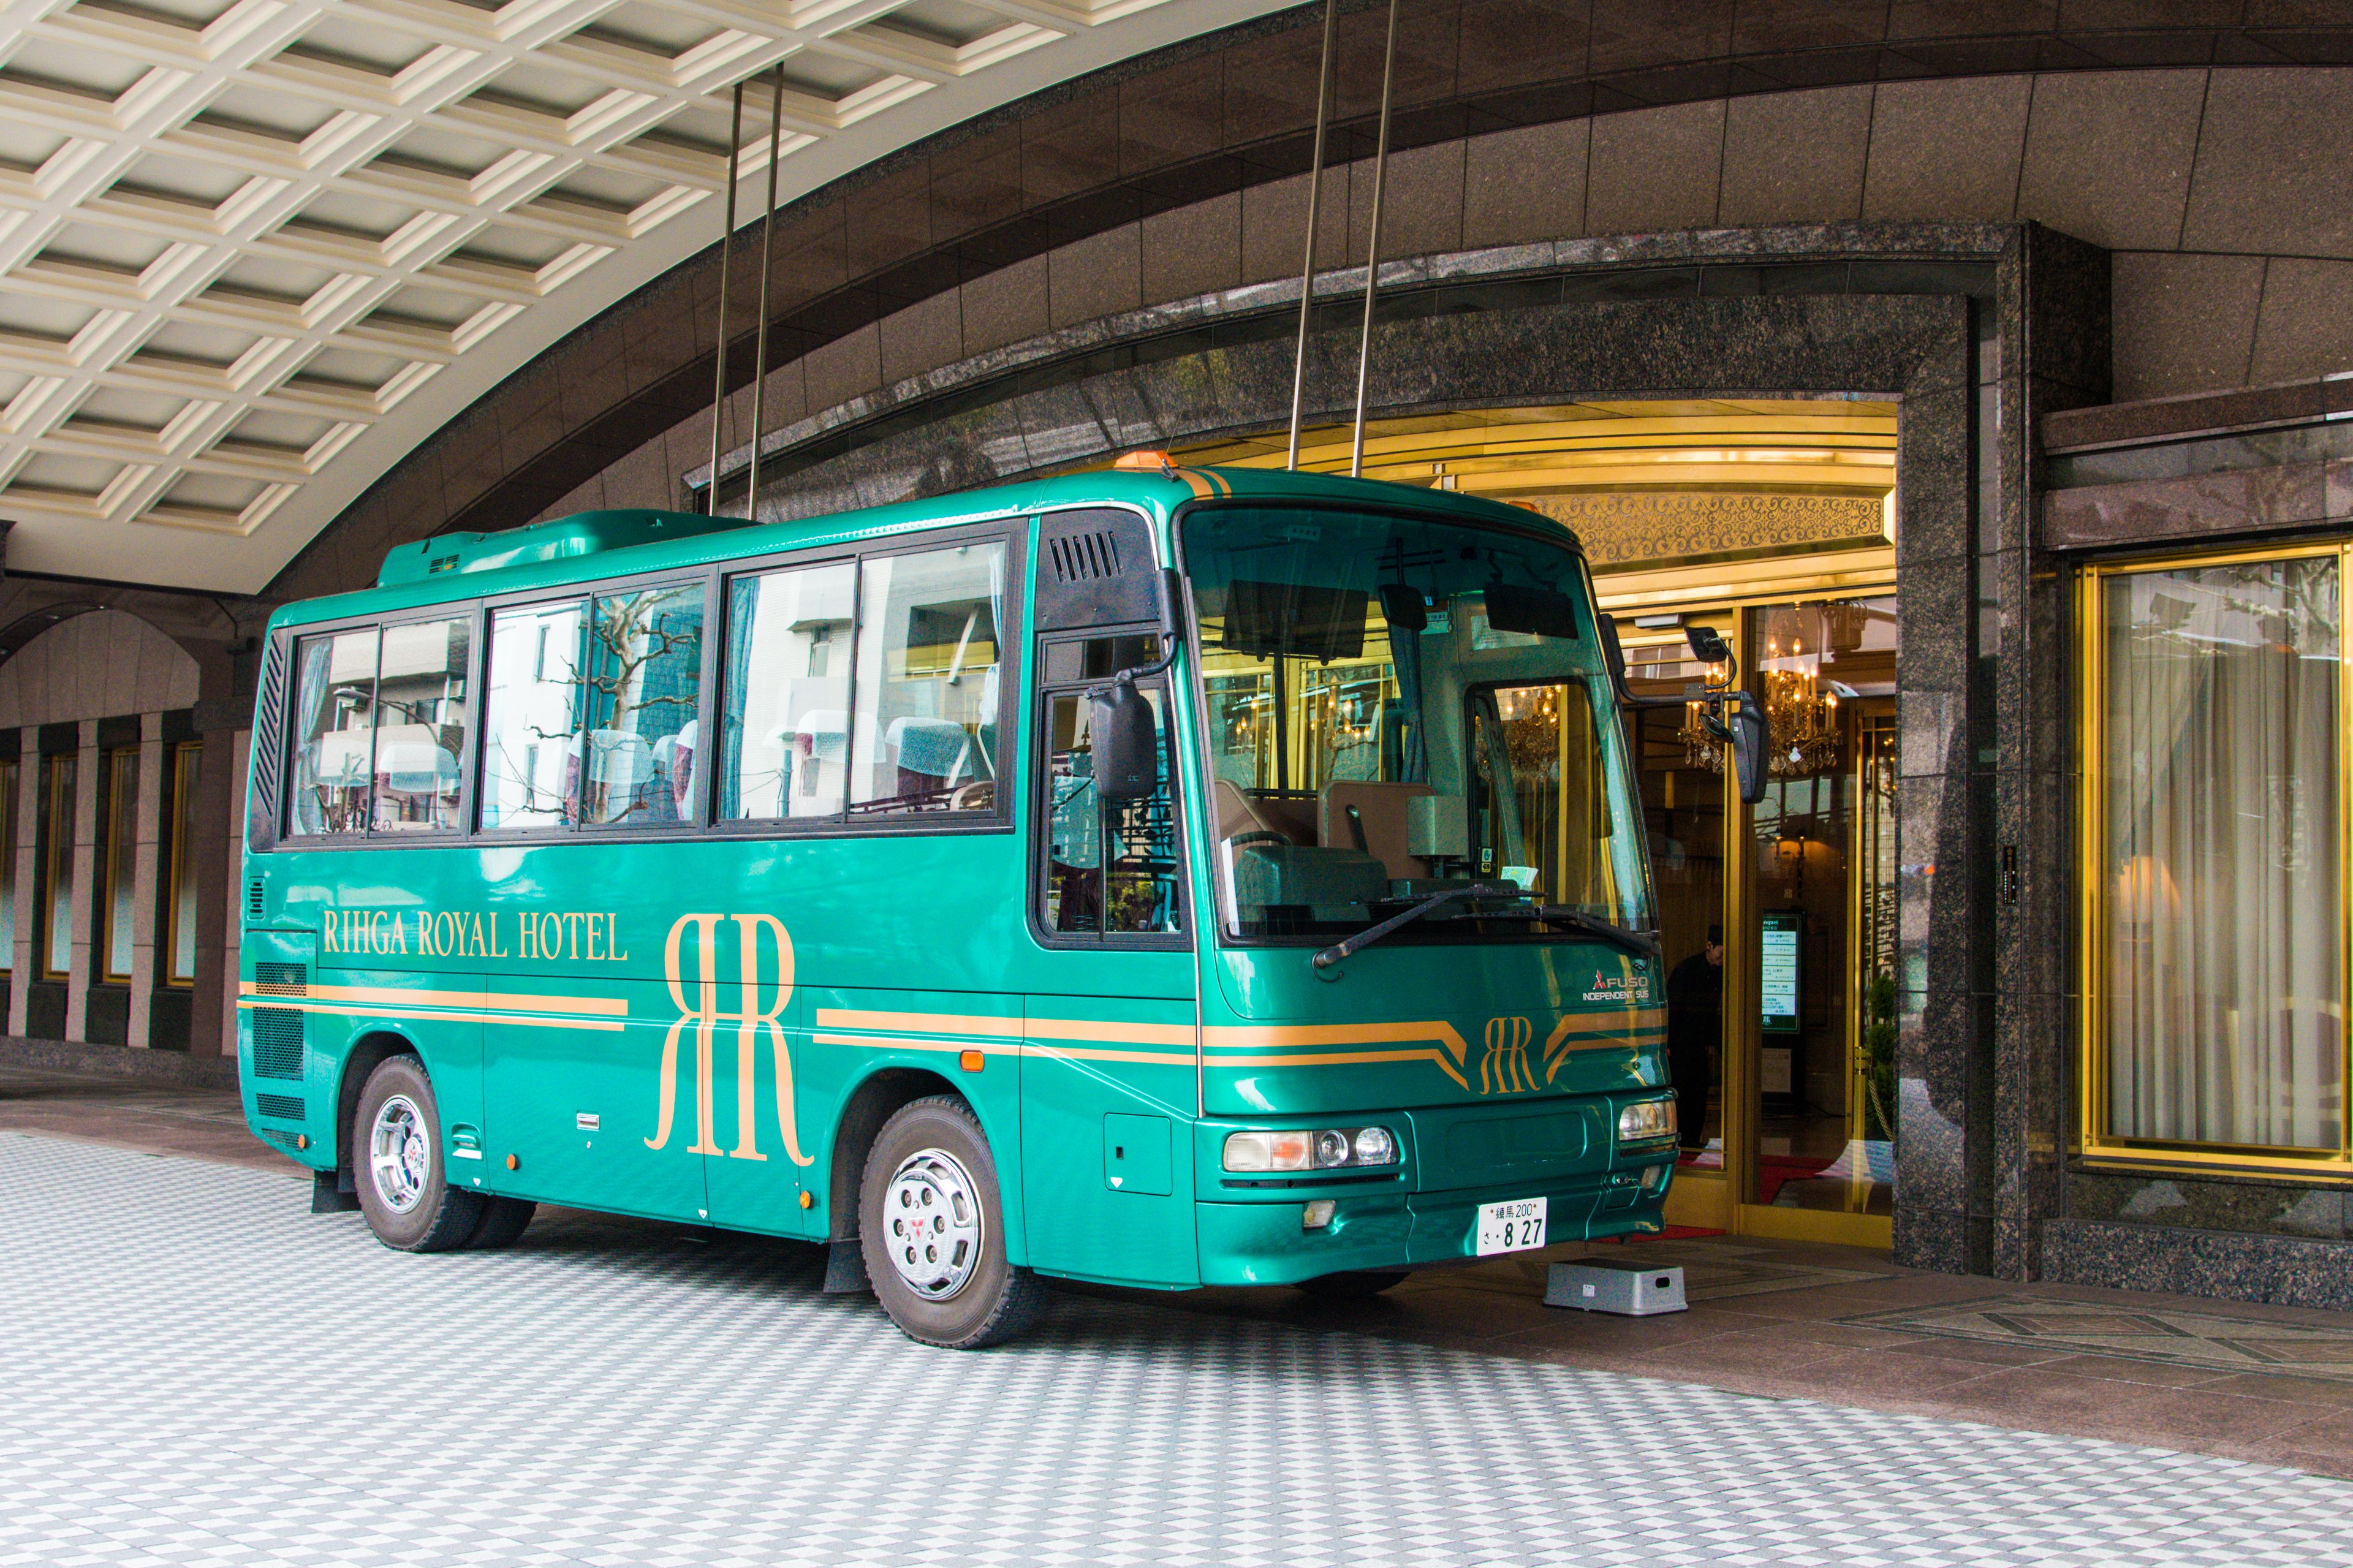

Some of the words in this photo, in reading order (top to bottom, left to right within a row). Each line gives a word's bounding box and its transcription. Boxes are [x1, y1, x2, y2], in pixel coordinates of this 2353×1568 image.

[324, 910, 407, 955] RIHGA
[418, 911, 508, 958] ROYAL
[518, 912, 628, 961] HOTEL
[1607, 977, 1648, 988] FUSO
[1583, 991, 1632, 1001] INDEPENDENT
[1635, 990, 1649, 999] SUS
[1515, 1203, 1533, 1218] 200
